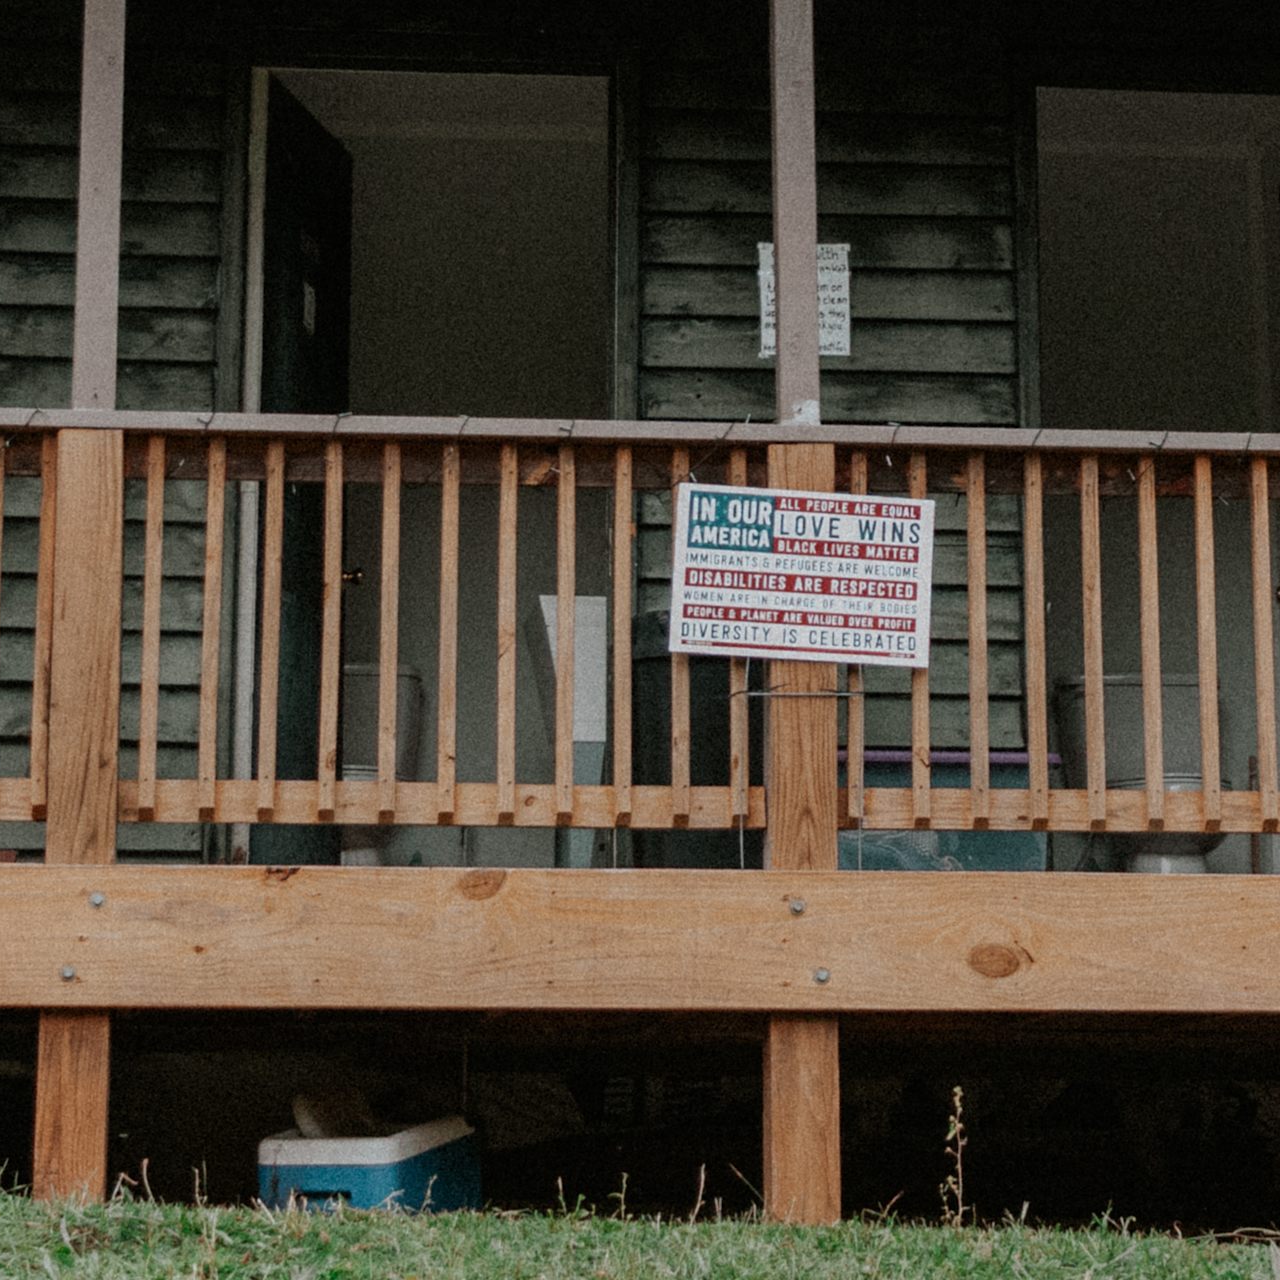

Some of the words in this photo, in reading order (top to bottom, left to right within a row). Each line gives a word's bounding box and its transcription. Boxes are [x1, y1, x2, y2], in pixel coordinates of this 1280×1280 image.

[692, 496, 716, 522] IN
[727, 499, 772, 526] OUR
[780, 498, 800, 510] ALL
[806, 500, 849, 513] PEOPLE
[854, 503, 876, 516] ARE
[881, 505, 917, 519] EQUAL
[691, 525, 770, 548] AMERICA
[780, 514, 840, 539] LOVE
[858, 519, 921, 544] WINS
[777, 540, 817, 554] BLACK
[823, 543, 860, 557] LIVES
[866, 547, 915, 561] MATTER
[685, 552, 758, 568] IMMIGRANTS
[775, 559, 833, 573] REFUGEES
[837, 562, 859, 575] ARE
[864, 564, 919, 578] WELCOME
[689, 570, 787, 590] DISABILITIES
[794, 576, 823, 593] ARE
[830, 579, 914, 599] RESPECTED
[683, 590, 724, 602] WOMEN
[730, 593, 751, 604] ARE
[774, 596, 816, 609] CHARGE
[822, 599, 835, 610] OF
[842, 600, 873, 612] THEIR
[880, 602, 918, 615] BODIES
[687, 606, 724, 619] PEOPLE
[741, 609, 779, 622] PLANET
[783, 612, 803, 624] ARE
[806, 613, 845, 626] VALUED
[848, 616, 874, 628] OVER
[878, 618, 913, 631] PROFIT
[681, 622, 771, 643] DIVERSITY
[782, 628, 798, 644] IS
[808, 630, 917, 652] CELEBRATED
